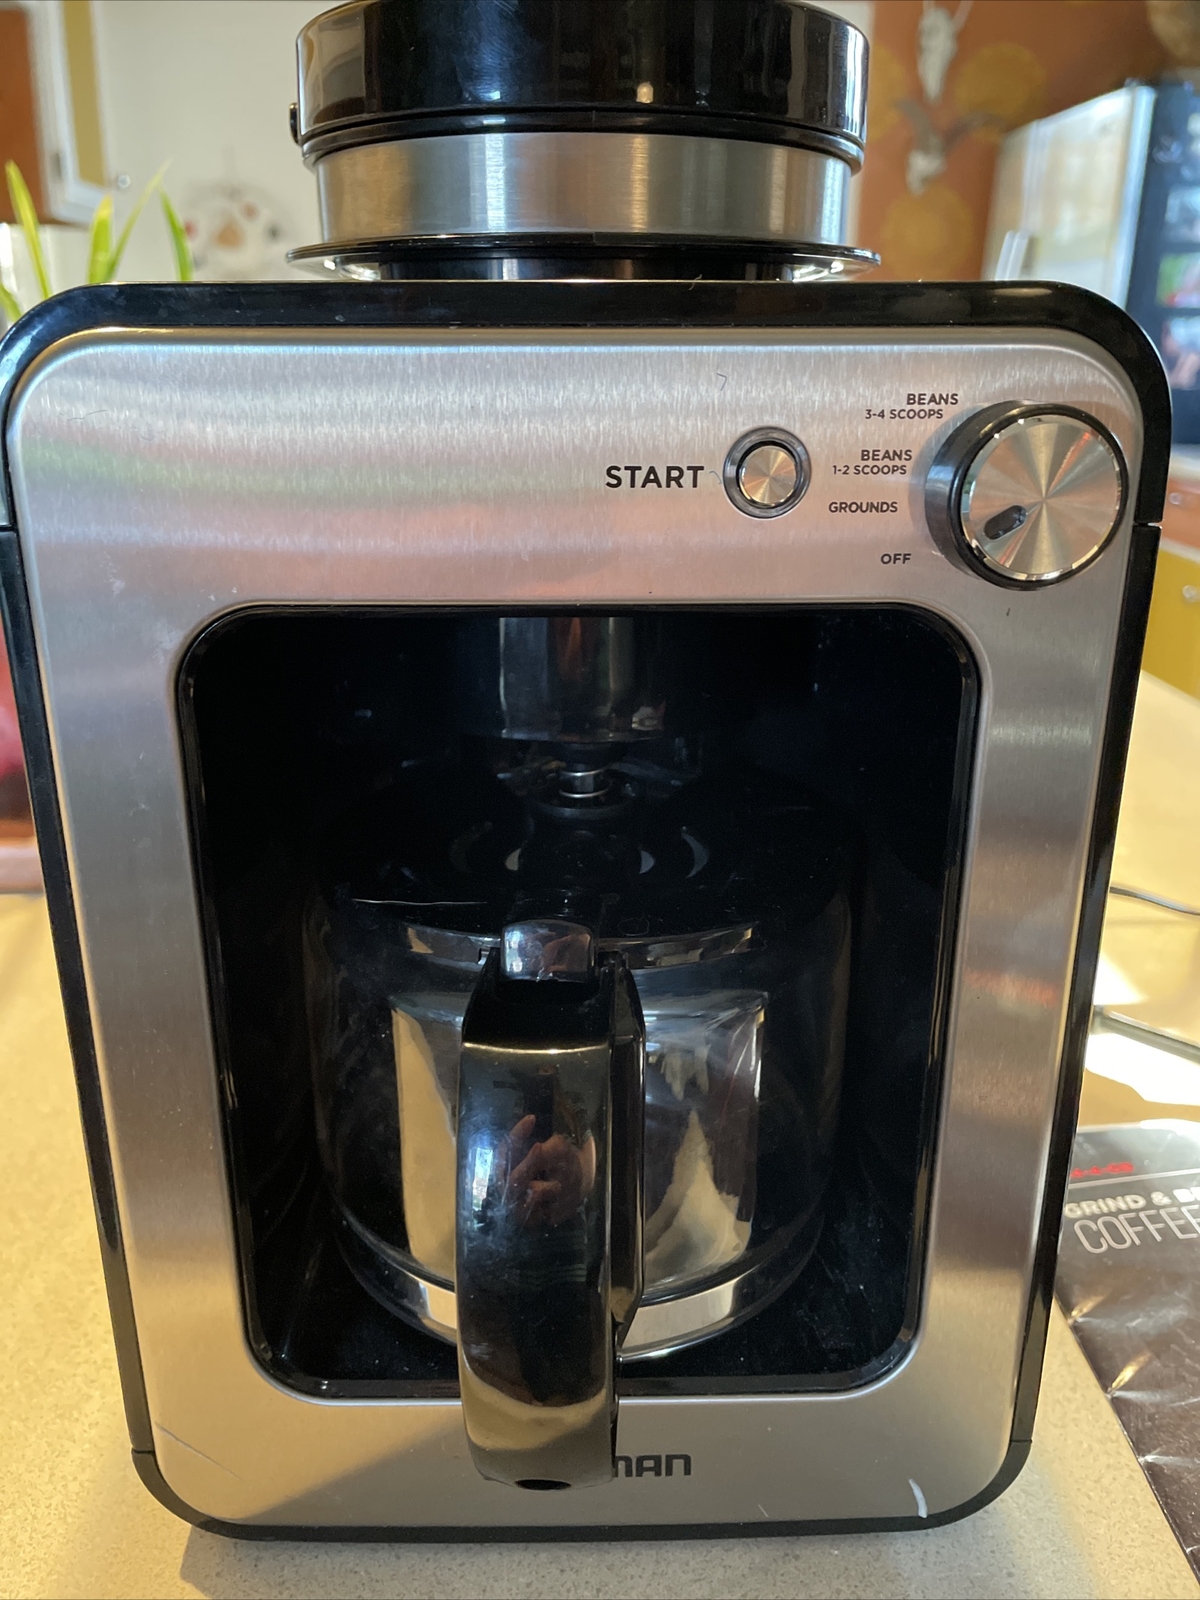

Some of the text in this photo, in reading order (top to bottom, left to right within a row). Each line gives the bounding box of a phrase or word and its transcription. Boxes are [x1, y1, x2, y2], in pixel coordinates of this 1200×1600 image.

[907, 393, 958, 405] BEANS
[865, 409, 943, 419] 3-4 SCOOPS
[861, 450, 912, 461] BEANS
[833, 465, 906, 475] 1-2 SCOOPS
[605, 466, 704, 488] START
[829, 502, 897, 513] GROUNDS
[881, 553, 911, 564] OFF
[1065, 1194, 1146, 1218] GRIND
[1151, 1191, 1172, 1206] &
